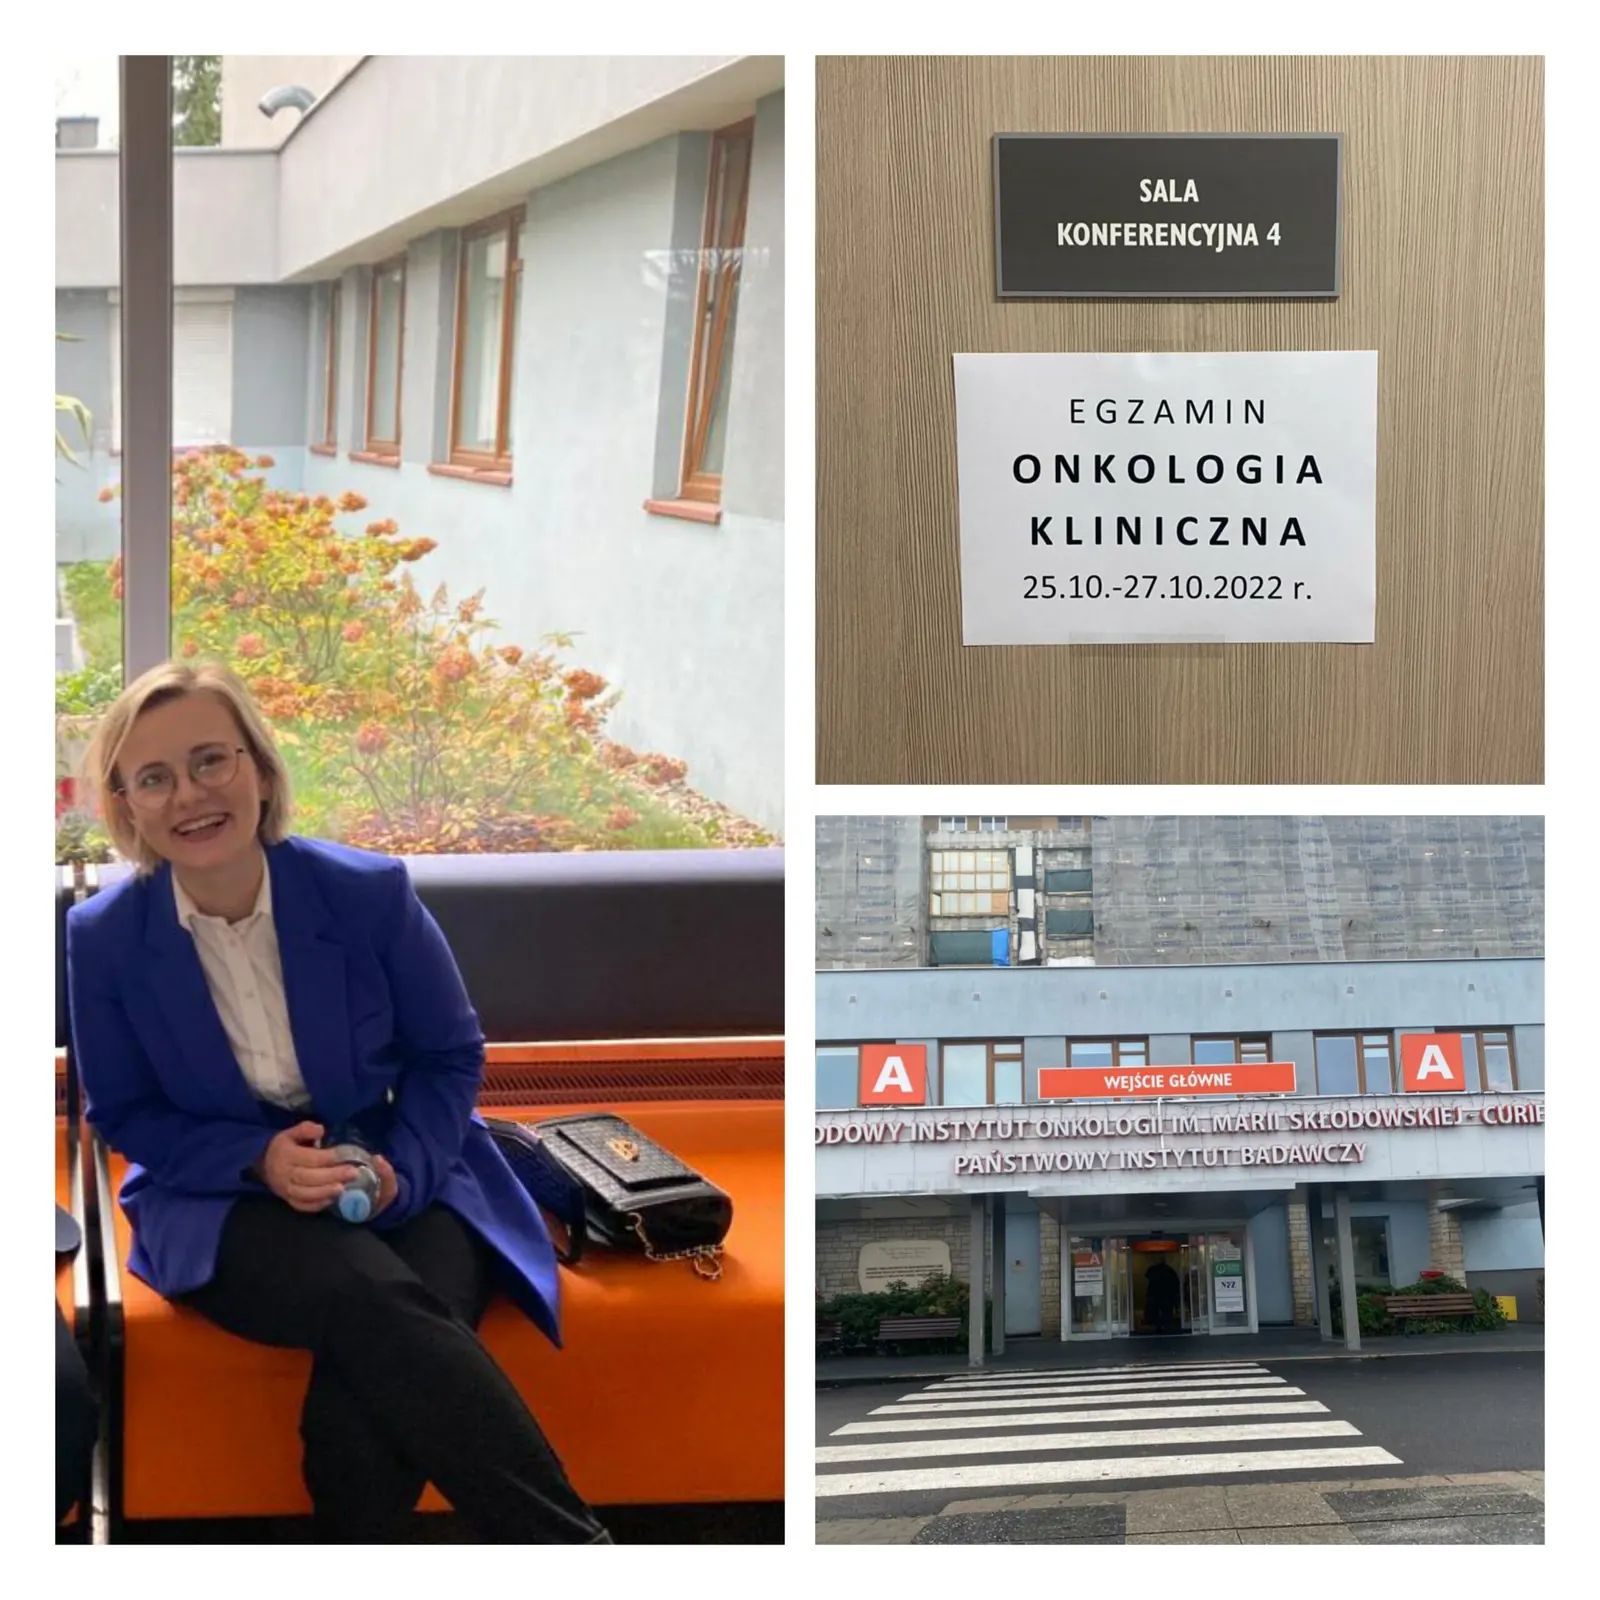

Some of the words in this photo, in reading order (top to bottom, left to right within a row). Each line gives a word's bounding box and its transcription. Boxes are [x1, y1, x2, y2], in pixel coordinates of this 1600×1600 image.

[1139, 178, 1200, 203] SALA
[1057, 222, 1260, 253] KONFERENCYJNA
[1266, 222, 1282, 246] 4
[1069, 398, 1266, 425] EGZAMIN
[1012, 453, 1323, 485] ONKOLOGIA
[1031, 516, 1307, 547] KLINICZNA
[1023, 574, 1283, 600] 25.10.-27.10.2022
[1294, 581, 1312, 600] r.
[873, 1056, 913, 1093] A
[1416, 1044, 1454, 1080] A
[1103, 1072, 1165, 1092] WEJŚCIE
[1168, 1070, 1233, 1088] GŁÓWNE
[910, 1118, 1028, 1142] INSTYTUT
[1035, 1116, 1163, 1139] ONKOLOGII
[1172, 1114, 1206, 1134] IM.
[1212, 1111, 1280, 1133] MARII
[1289, 1105, 1463, 1130] SKŁODOWSKIEJ
[1481, 1103, 1545, 1126] CURIE
[954, 1149, 1110, 1175] PAŃSTWOWY
[1119, 1147, 1232, 1169] INSTYTUT
[1241, 1143, 1367, 1165] BADAWCZY
